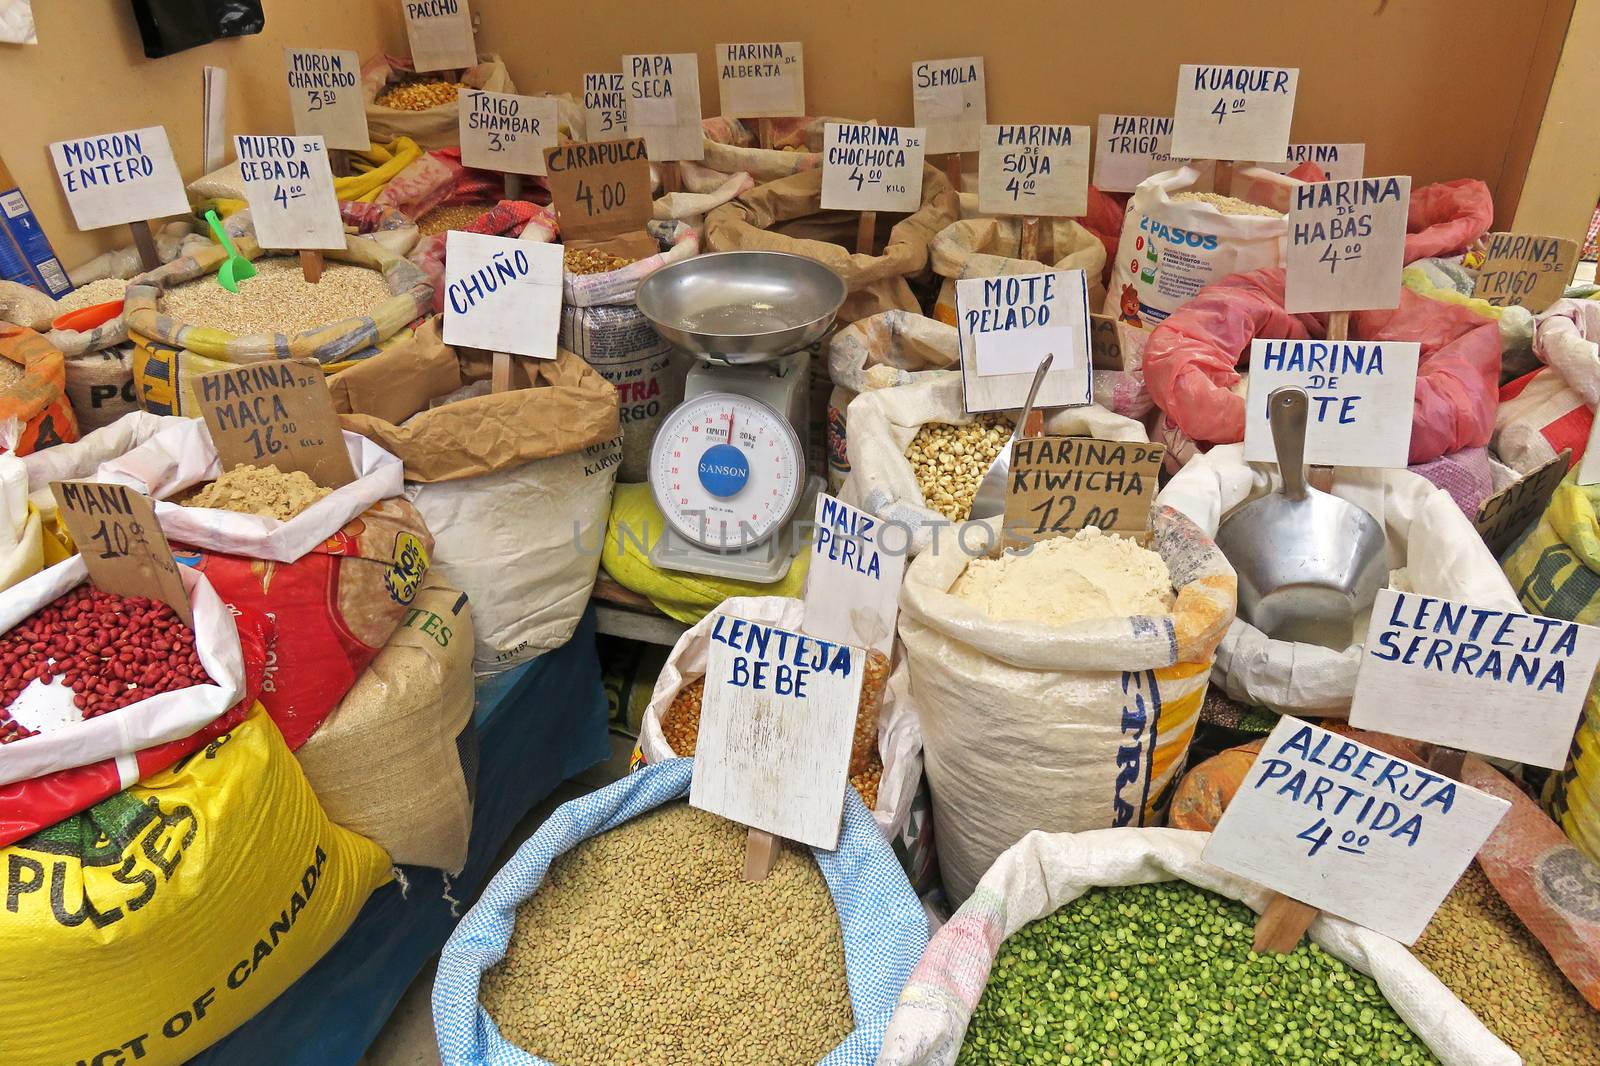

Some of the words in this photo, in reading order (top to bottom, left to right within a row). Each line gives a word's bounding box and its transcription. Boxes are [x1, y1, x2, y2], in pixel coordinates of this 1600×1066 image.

[407, 0, 457, 19] PACCHO
[293, 54, 341, 71] MORON
[727, 43, 783, 61] HARINA
[784, 55, 797, 64] DE
[632, 56, 673, 78] PAPA
[722, 64, 781, 79] ALBERJA
[917, 64, 976, 87] SEMOLA
[288, 72, 356, 88] CHANCADO
[586, 74, 625, 91] MAIZ
[632, 78, 673, 99] SECA
[1194, 67, 1289, 94] KUAQUER
[467, 92, 519, 116] TRIGO
[585, 92, 627, 110] CANCH
[469, 113, 541, 136] SHAMBAR
[838, 124, 900, 146] HARINA
[906, 139, 920, 148] DE
[997, 126, 1072, 147] HARINA
[1113, 117, 1173, 135] HARIN
[63, 134, 141, 166] MORON
[304, 143, 320, 153] DE
[548, 139, 648, 172] CARAPULCA
[829, 147, 906, 168] CHOCHOCA
[1024, 146, 1039, 156] DE
[1109, 137, 1157, 154] TRIGO
[1287, 145, 1338, 163] ARINA
[63, 156, 153, 192] ENTERO
[241, 161, 309, 181] CEBADA
[1003, 154, 1051, 179] SOYA
[575, 181, 625, 217] 4.00
[886, 184, 906, 194] KILO
[1297, 178, 1401, 211] HARINA
[1336, 205, 1356, 216] DE
[1151, 221, 1218, 251] PASOS
[1294, 214, 1373, 246] HABAS
[1488, 235, 1558, 262] HARINA
[1542, 263, 1562, 272] DE
[448, 249, 530, 315] CHUÑO
[984, 274, 1056, 309] MOTE
[1482, 271, 1537, 294] TRIGO
[966, 304, 1050, 335] PELADO
[1263, 342, 1383, 375] HARINA
[201, 364, 297, 403] HARINA
[297, 376, 315, 387] DE
[1305, 375, 1338, 389] DE
[215, 394, 288, 431] MACA
[620, 400, 660, 424] RGO
[1013, 440, 1126, 467] HARINA
[1133, 448, 1162, 465] DE
[700, 463, 747, 478] SANSON
[1012, 470, 1143, 496] KIWICHA
[62, 483, 133, 516] MANI
[821, 499, 874, 541] MAIZ
[817, 527, 880, 580] PERLA
[404, 607, 453, 648] TES
[1390, 594, 1579, 657] LENTEJA
[712, 616, 851, 679] LENTEJA
[1371, 631, 1565, 693] SERRANA
[727, 657, 811, 698] BEBE
[1278, 726, 1457, 815] ALBERJA
[1255, 759, 1423, 846] PARTIDA
[162, 987, 216, 1038] OF
[226, 844, 326, 990] CANADA
